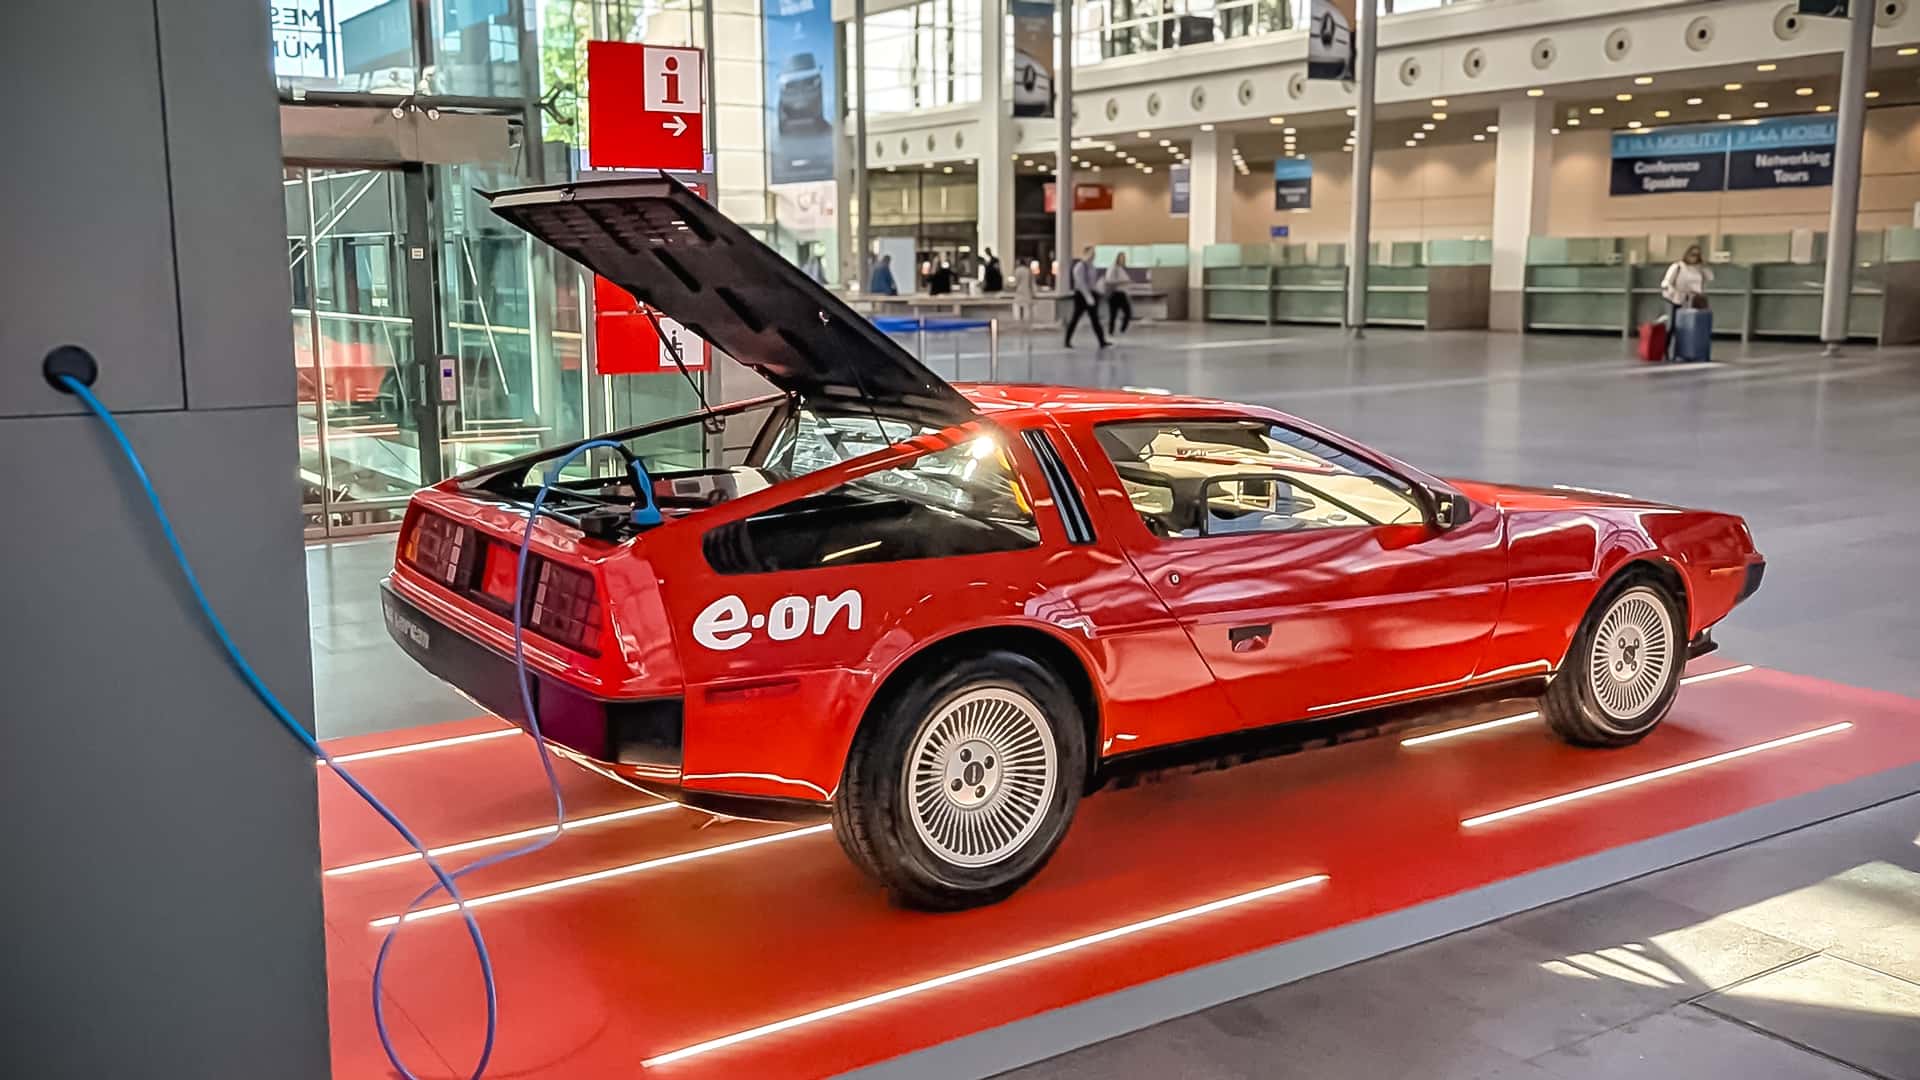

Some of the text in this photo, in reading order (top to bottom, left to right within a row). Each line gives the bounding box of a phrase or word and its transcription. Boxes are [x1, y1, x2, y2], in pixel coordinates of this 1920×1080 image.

[1755, 152, 1831, 168] Networking
[1634, 161, 1700, 175] Conference
[1643, 176, 1690, 192] Speaker
[1774, 169, 1809, 184] Tours
